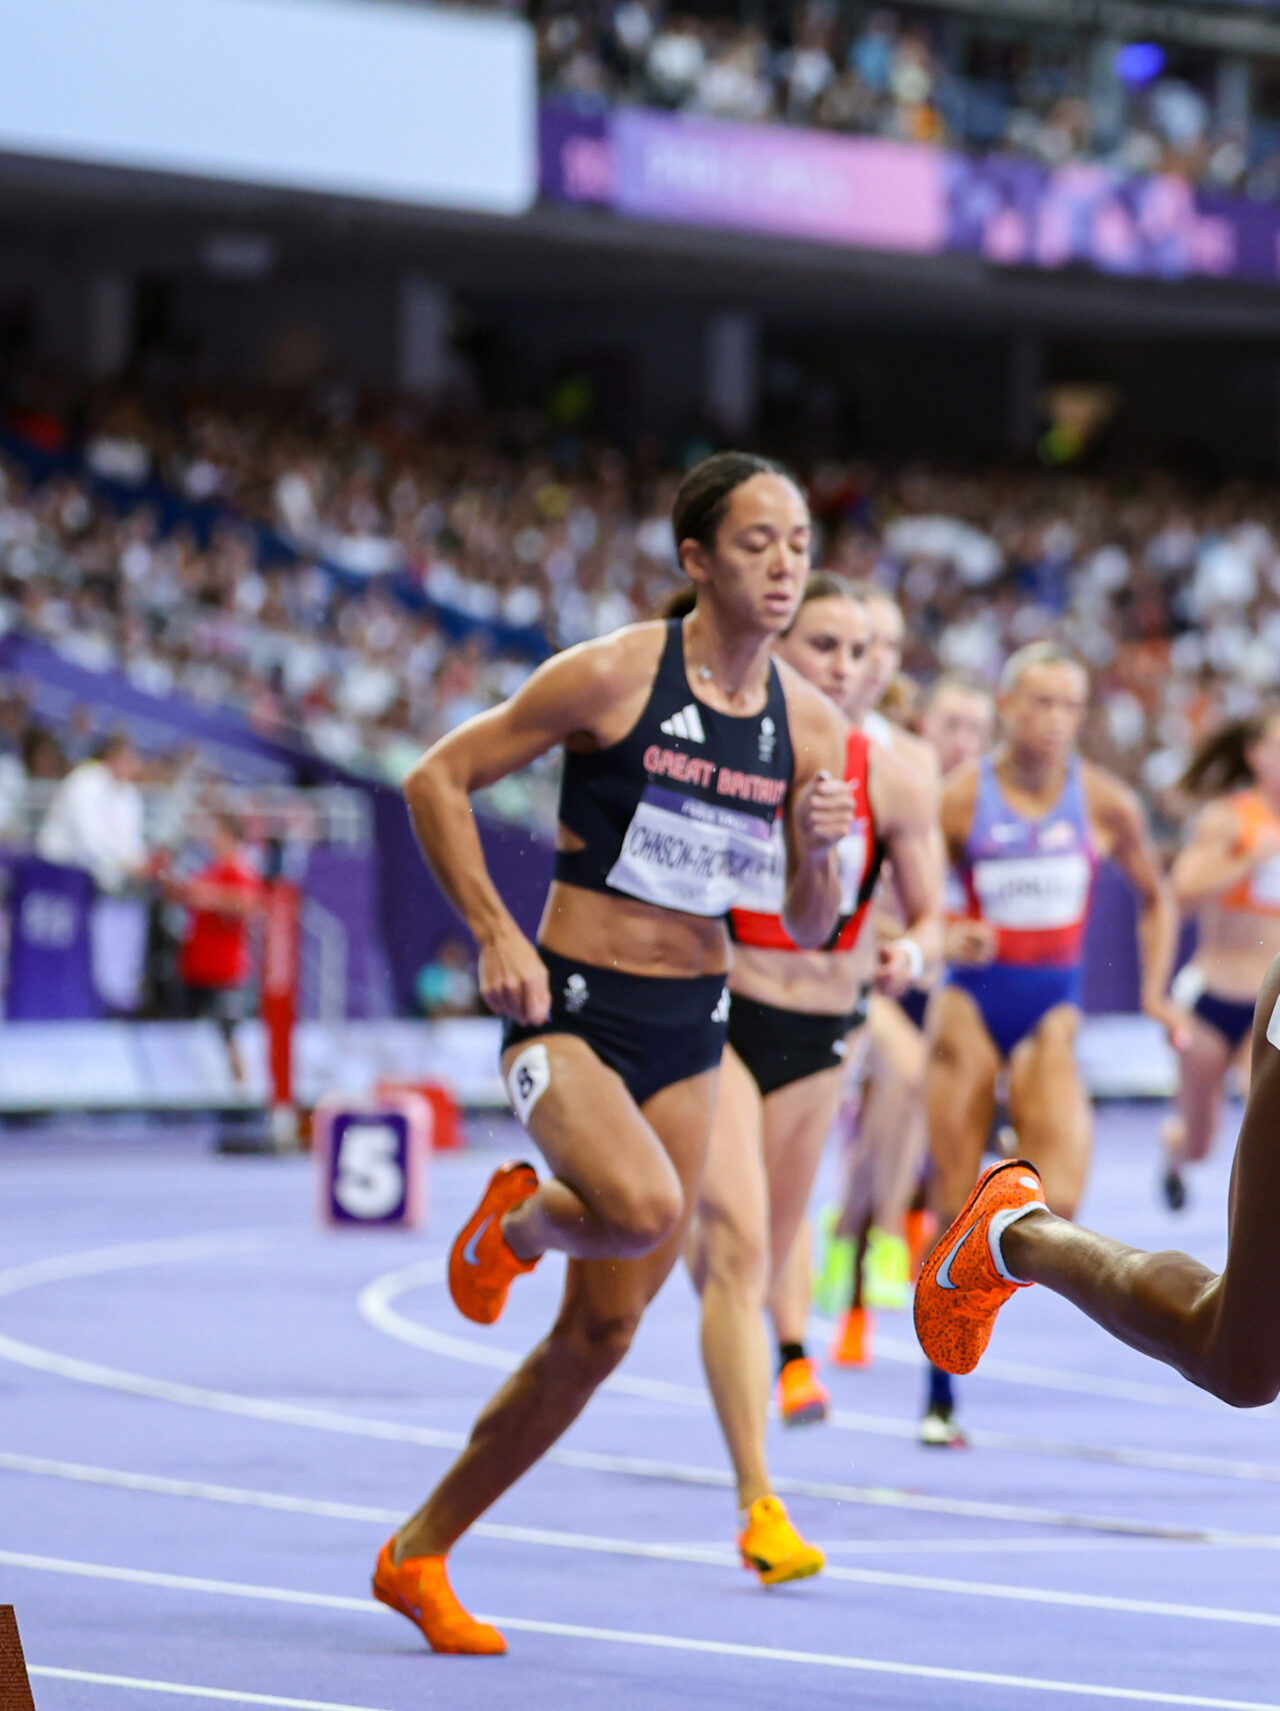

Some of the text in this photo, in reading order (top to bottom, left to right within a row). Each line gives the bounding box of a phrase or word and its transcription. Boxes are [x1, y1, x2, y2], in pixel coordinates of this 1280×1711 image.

[643, 744, 786, 805] GREAT BRITAIN
[336, 1125, 403, 1219] 5
